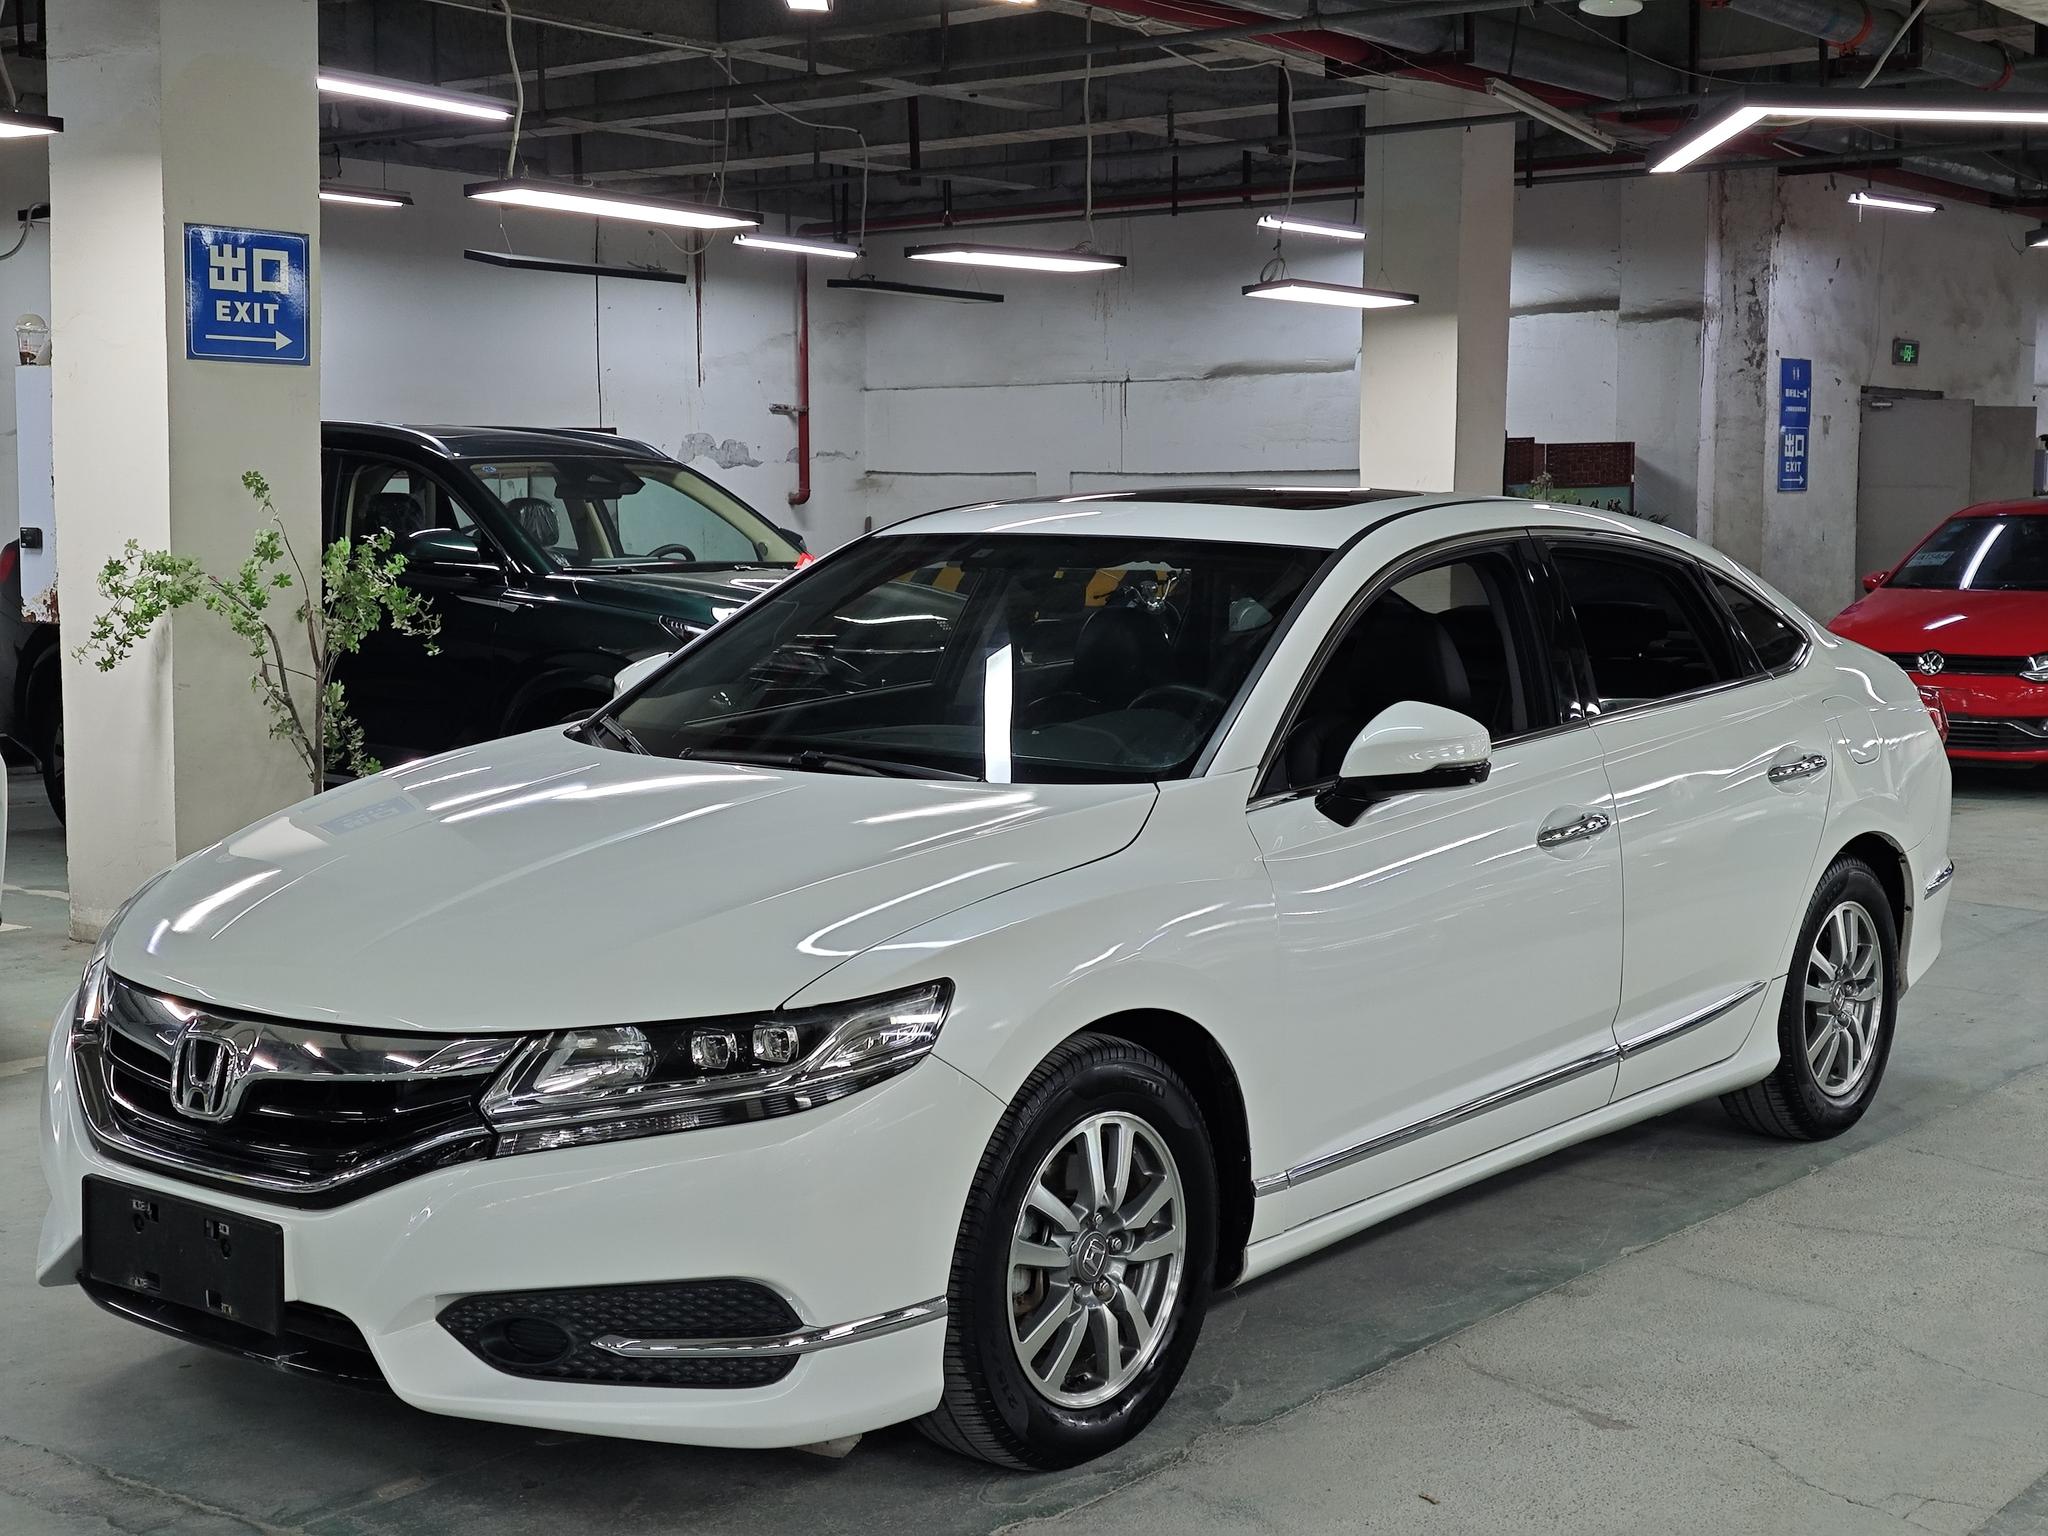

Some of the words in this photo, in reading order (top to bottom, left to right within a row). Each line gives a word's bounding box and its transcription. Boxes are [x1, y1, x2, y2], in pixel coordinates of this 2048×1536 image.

[209, 244, 289, 294] 出口
[216, 300, 280, 324] EXIT
[1784, 433, 1805, 457] 出口
[1785, 461, 1801, 472] EXIT
